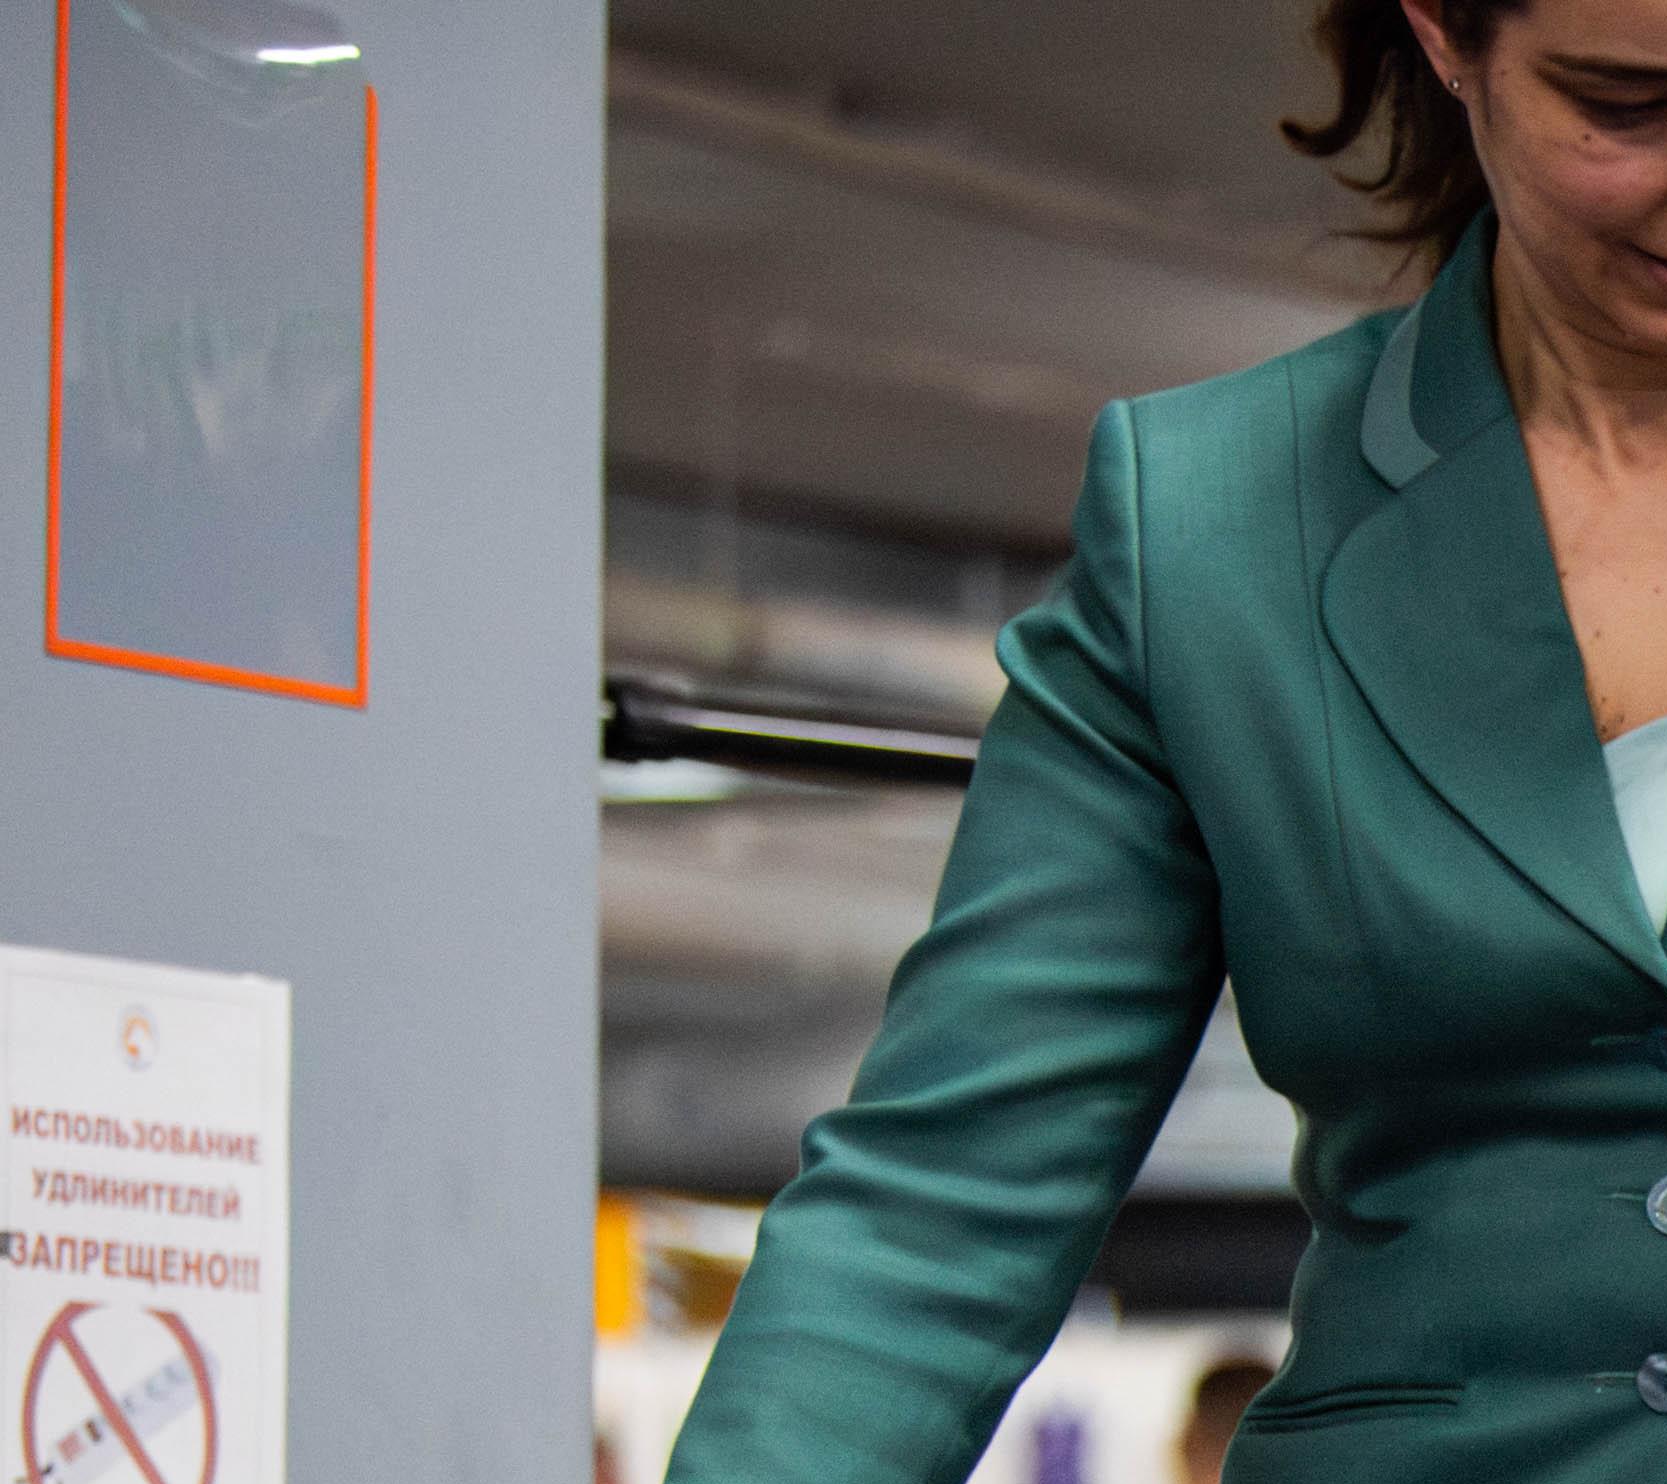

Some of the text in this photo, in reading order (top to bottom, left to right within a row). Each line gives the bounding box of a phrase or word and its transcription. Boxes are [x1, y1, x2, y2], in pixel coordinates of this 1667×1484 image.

[10, 1104, 262, 1165] ИСПОЛЬЗОВАНИЕ
[32, 1166, 242, 1219] УДЛИНИТЕЛЕЙ
[8, 1230, 262, 1293] ЗАПРЕЩЕНО!!!
